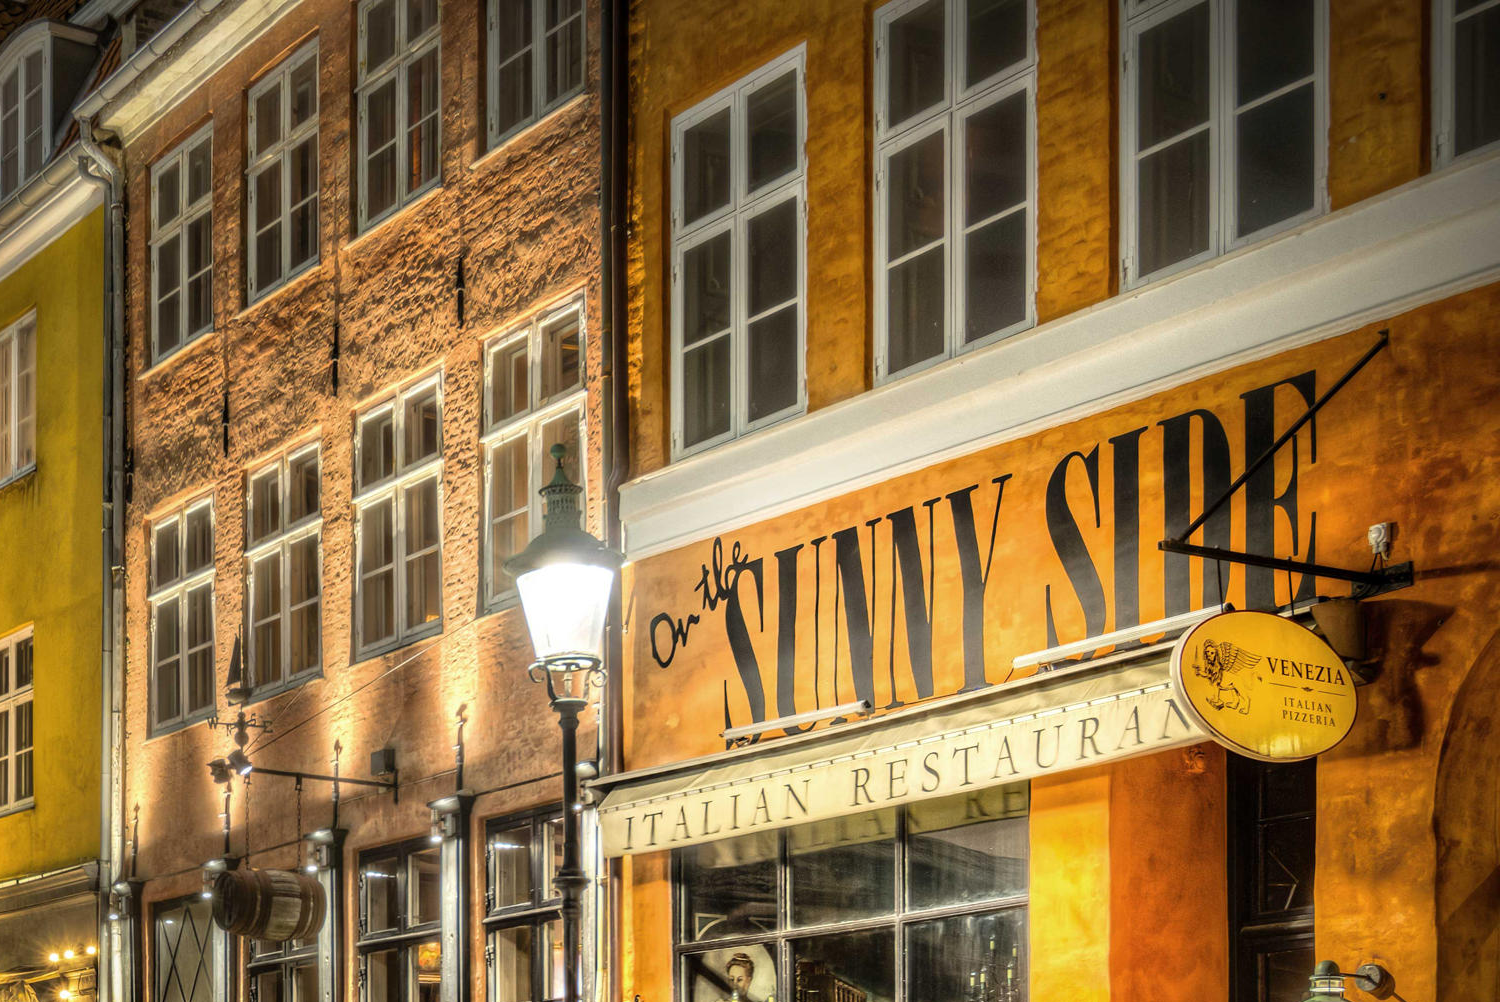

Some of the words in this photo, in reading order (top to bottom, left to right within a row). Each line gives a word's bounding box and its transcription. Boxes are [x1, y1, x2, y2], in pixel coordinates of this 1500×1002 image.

[722, 473, 1013, 750] SUNNY
[1045, 369, 1317, 674] SIDE
[649, 611, 700, 668] On
[694, 536, 749, 611] the
[1266, 656, 1346, 686] VENEZIA
[1283, 696, 1333, 713] ITALIAN
[1282, 709, 1336, 728] PIZZERIA
[621, 779, 812, 850] ITALIAN
[849, 698, 1194, 807] RESTAURAN
